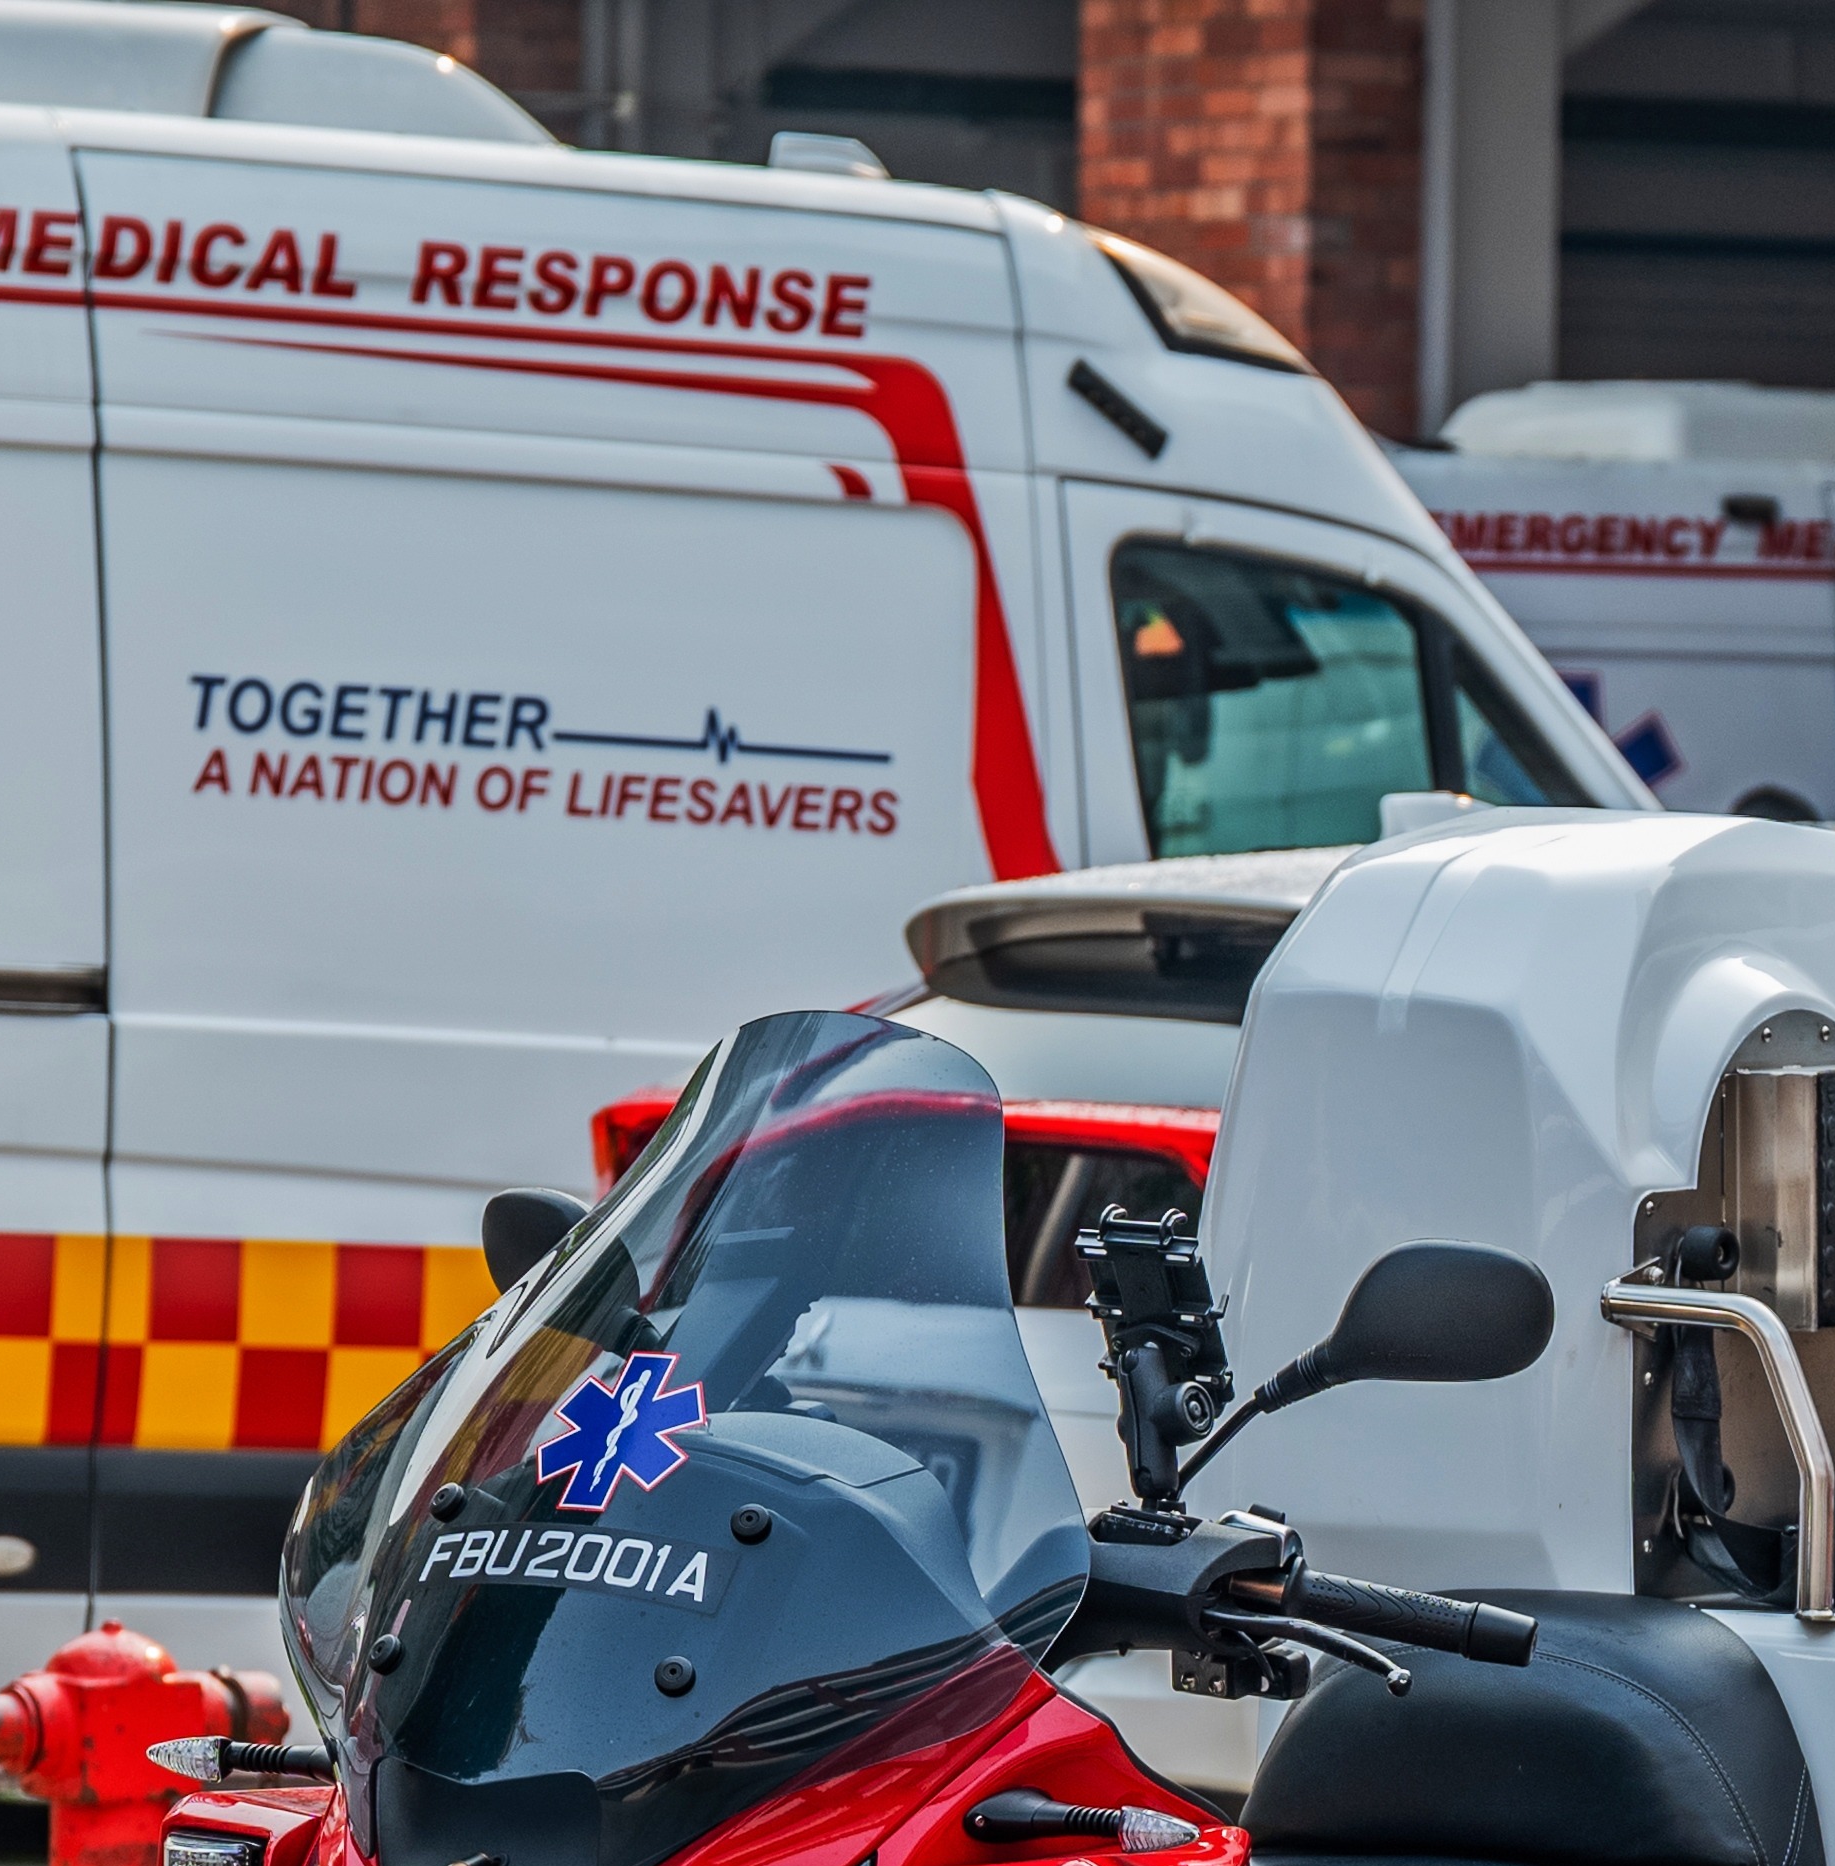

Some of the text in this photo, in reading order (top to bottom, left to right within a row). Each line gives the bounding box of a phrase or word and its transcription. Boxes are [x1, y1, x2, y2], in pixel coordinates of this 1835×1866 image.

[411, 239, 872, 340] RESPONSE
[188, 672, 550, 752] TOGETHER
[192, 748, 901, 836] A NATION OF LIFESAVERS
[418, 1528, 709, 1604] FBU2001A
